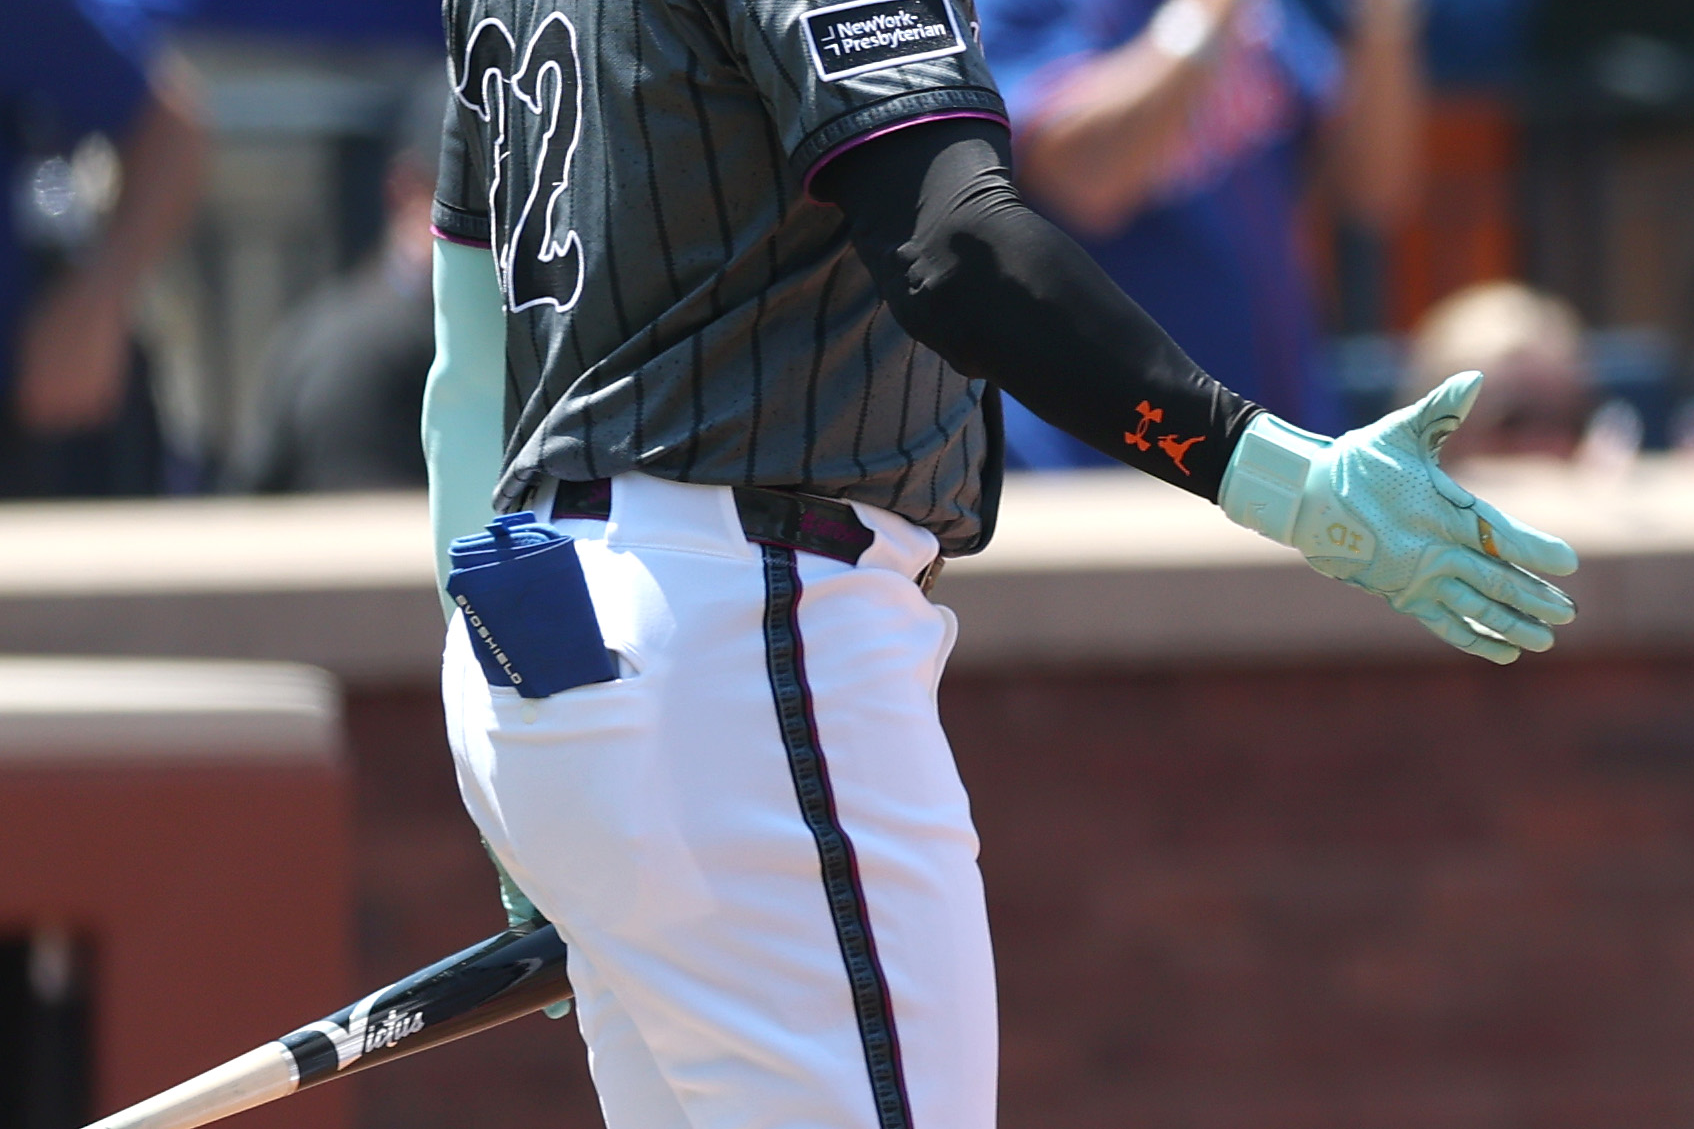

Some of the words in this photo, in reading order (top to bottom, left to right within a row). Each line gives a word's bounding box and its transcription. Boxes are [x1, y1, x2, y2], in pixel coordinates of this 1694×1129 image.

[836, 10, 918, 38] NewYork-
[841, 23, 946, 54] Presbyterian
[278, 983, 426, 1071] Victus
